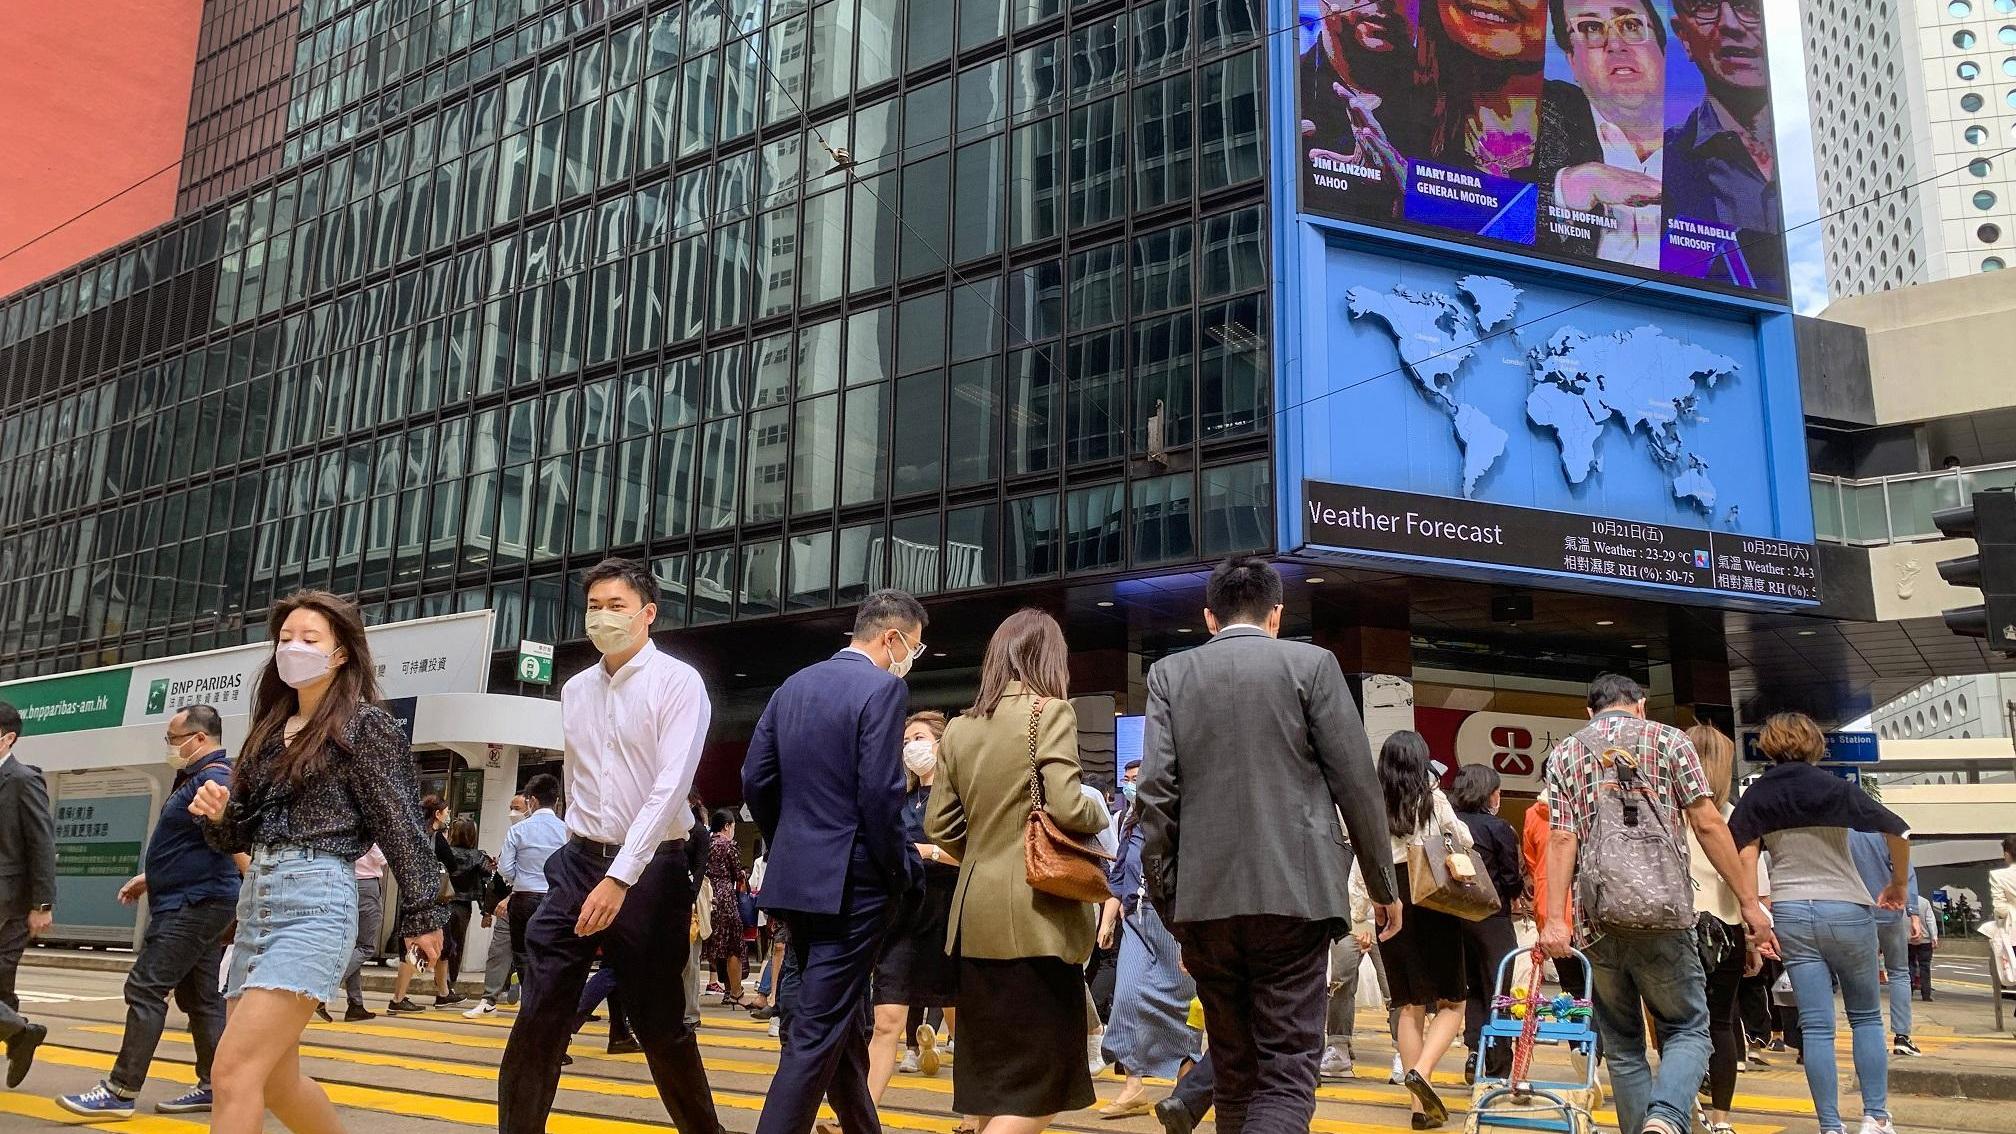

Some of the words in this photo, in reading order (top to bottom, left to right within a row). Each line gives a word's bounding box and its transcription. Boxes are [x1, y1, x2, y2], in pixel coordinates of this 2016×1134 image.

[1313, 157, 1332, 171] JIM
[1332, 161, 1382, 181] LANZONE
[1416, 165, 1446, 181] MARY
[1446, 171, 1482, 188] BARRA
[1313, 174, 1348, 190] YAHOO
[1417, 182, 1460, 200] GENERAL
[1460, 191, 1498, 207] MOTORS
[1548, 206, 1571, 220] REID
[1572, 211, 1617, 229] HOFFMAN
[1550, 222, 1591, 239] LINKEDIN
[1668, 219, 1697, 234] SATYA
[1697, 224, 1738, 241] NADELLA
[1669, 234, 1716, 252] MICROSOFT
[1407, 512, 1504, 545] Forecast
[1592, 521, 1664, 544] 10月21日(五)
[1564, 536, 1591, 553] 氣溫
[1593, 541, 1637, 558] Weather
[1646, 549, 1676, 563] 23-29
[1742, 541, 1809, 562] 10月22日(六)
[1564, 555, 1616, 575] 相對濕度
[1618, 563, 1637, 578] RH
[1665, 569, 1695, 584] 50-75
[1718, 555, 1742, 571] 氣溫
[1744, 560, 1785, 576] Weather
[1718, 573, 1766, 593] 相對濕度
[1768, 581, 1786, 594] RH
[402, 657, 447, 675] 可持續投資
[171, 680, 193, 696] BNP
[195, 673, 242, 692] PARIBAS
[1839, 735, 1872, 744] Station
